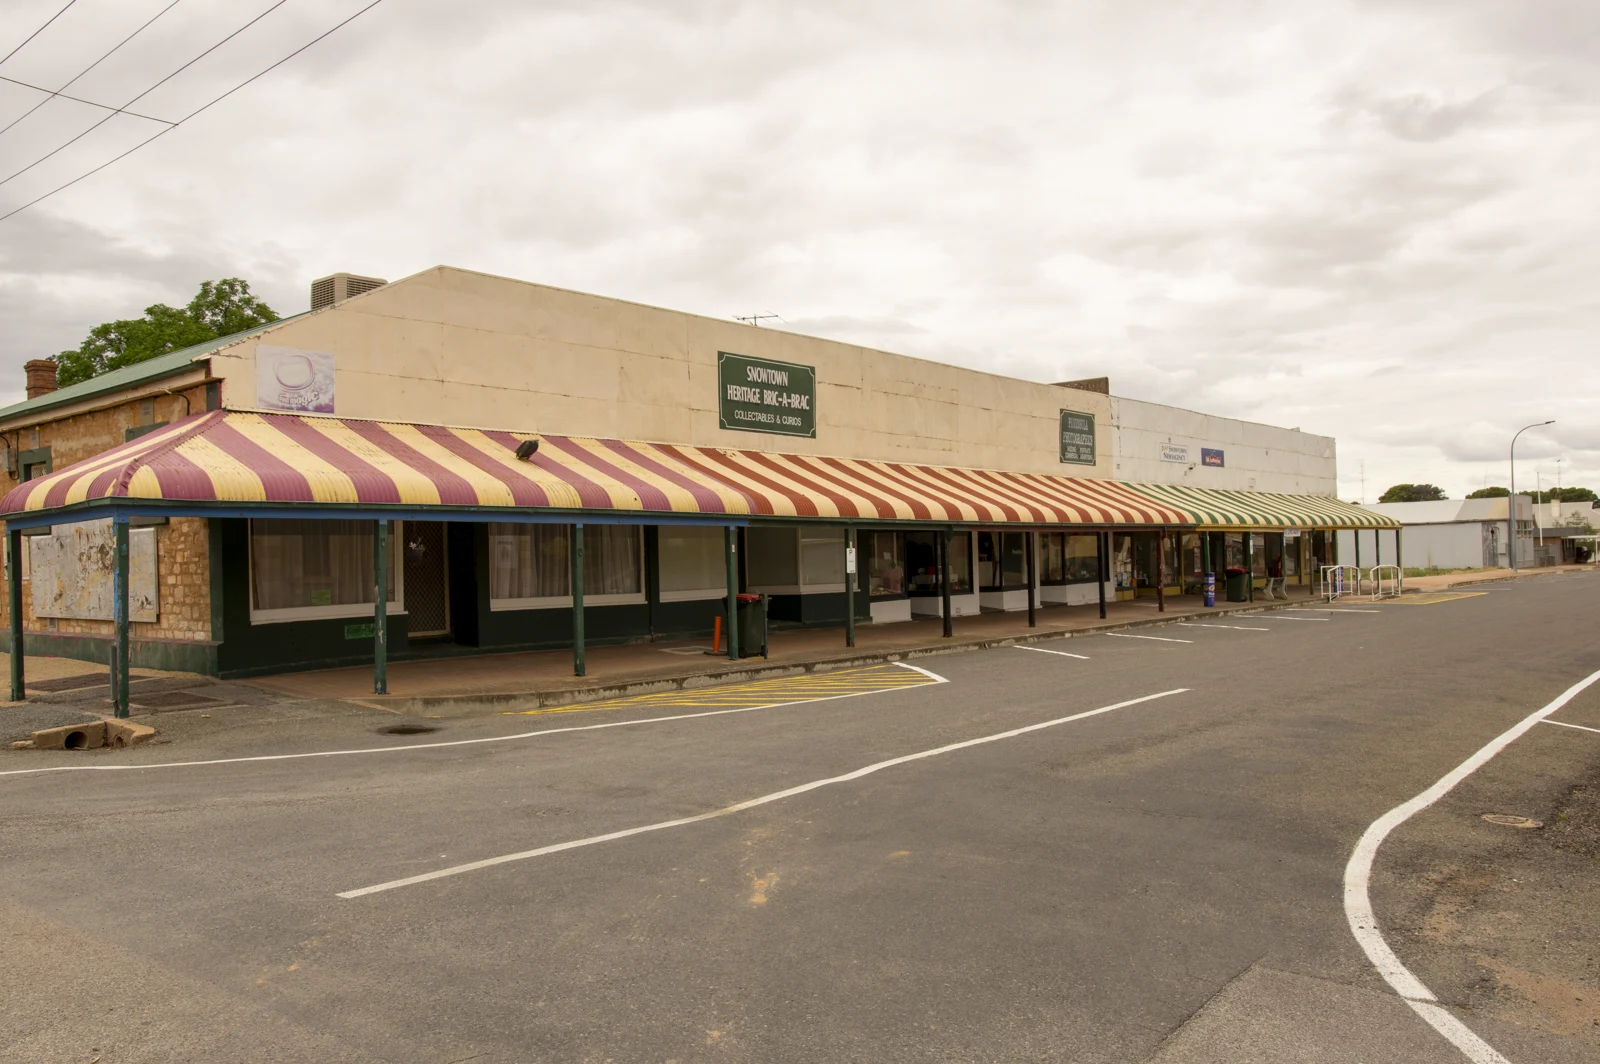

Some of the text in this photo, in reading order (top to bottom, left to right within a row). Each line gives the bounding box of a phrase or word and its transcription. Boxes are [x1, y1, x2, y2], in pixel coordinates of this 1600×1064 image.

[746, 366, 788, 386] SNOWTOWN
[727, 384, 810, 410] HERITAGE BRIC-A-BRAC
[734, 410, 801, 426] COLLECTABLES & CURIOS
